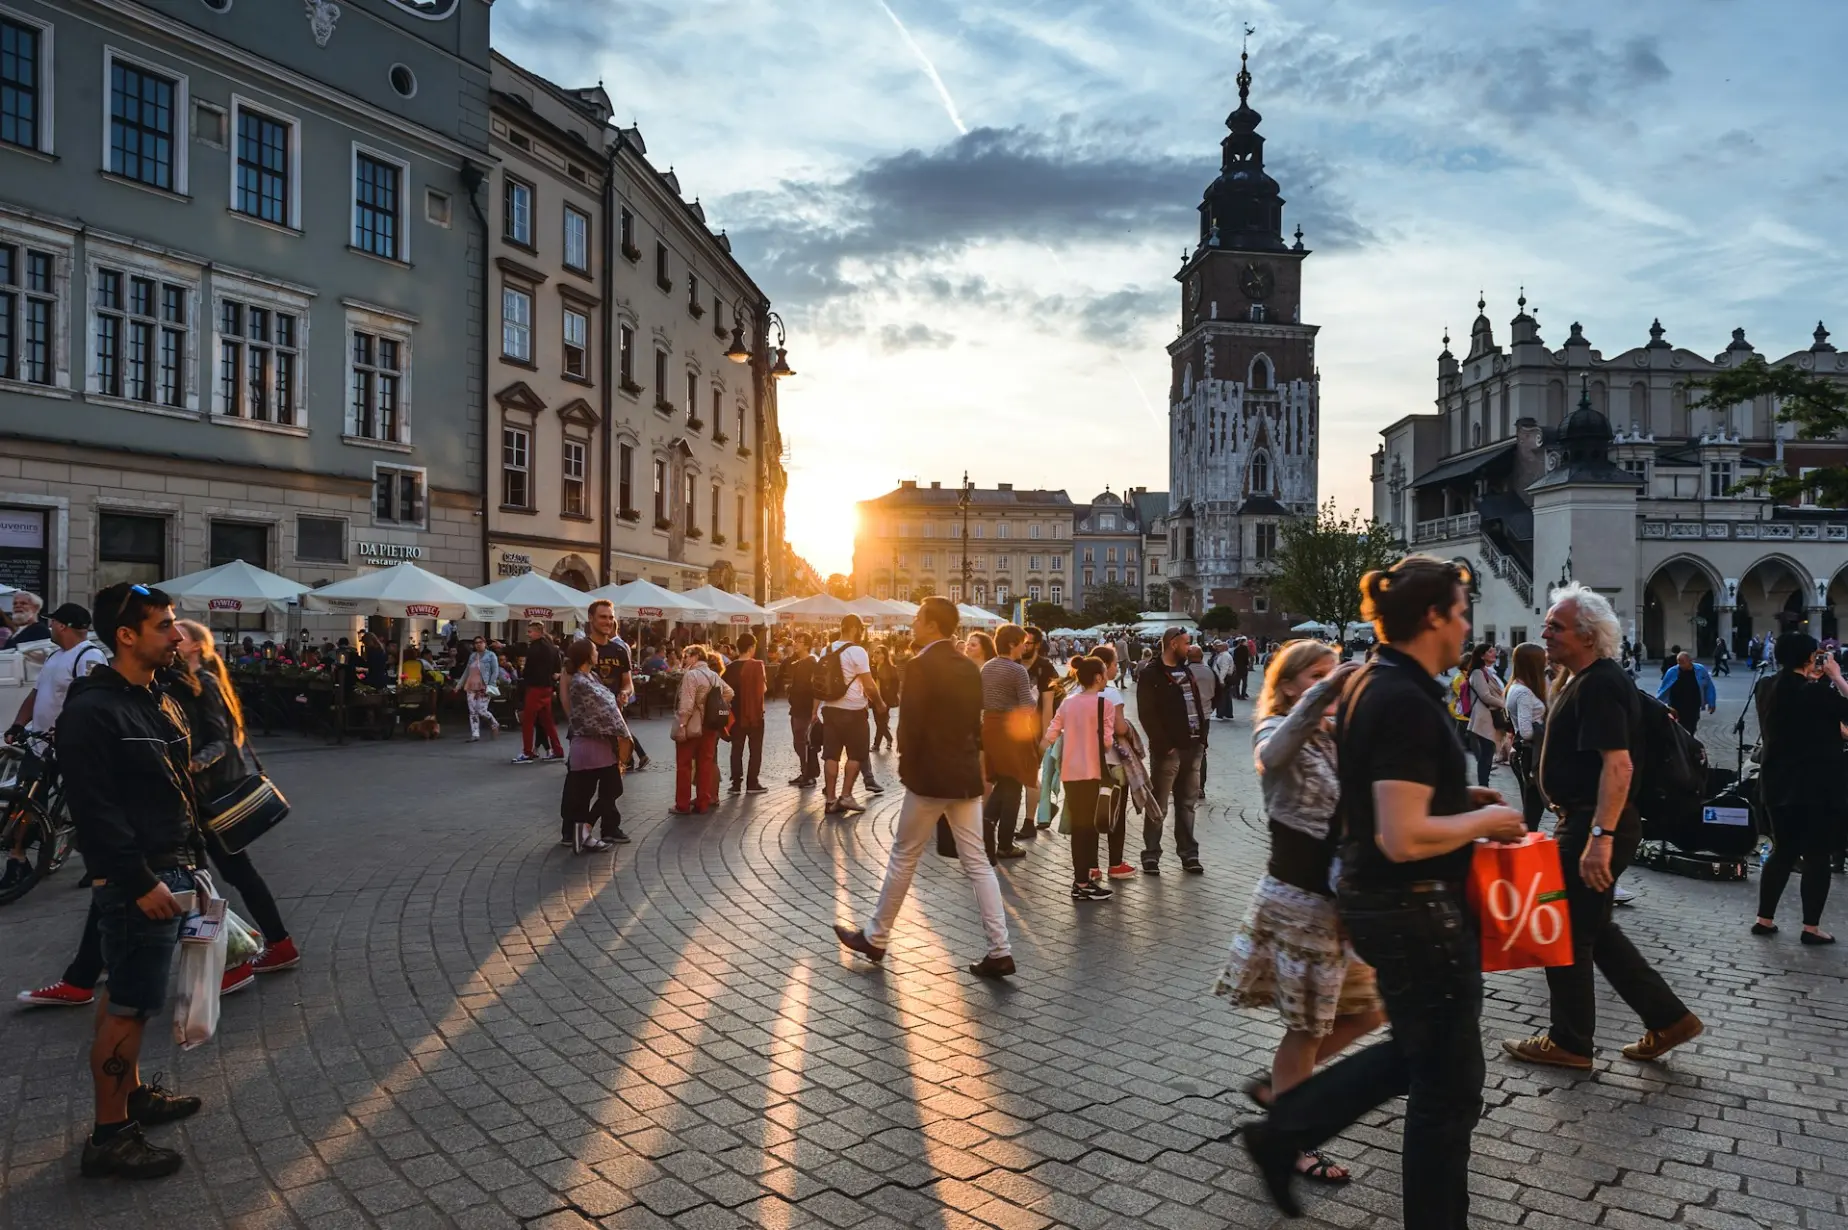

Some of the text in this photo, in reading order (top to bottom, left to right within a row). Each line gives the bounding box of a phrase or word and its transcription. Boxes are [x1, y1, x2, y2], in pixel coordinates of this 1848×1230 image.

[360, 542, 422, 559] DA PIETRO
[367, 558, 413, 566] restaura
